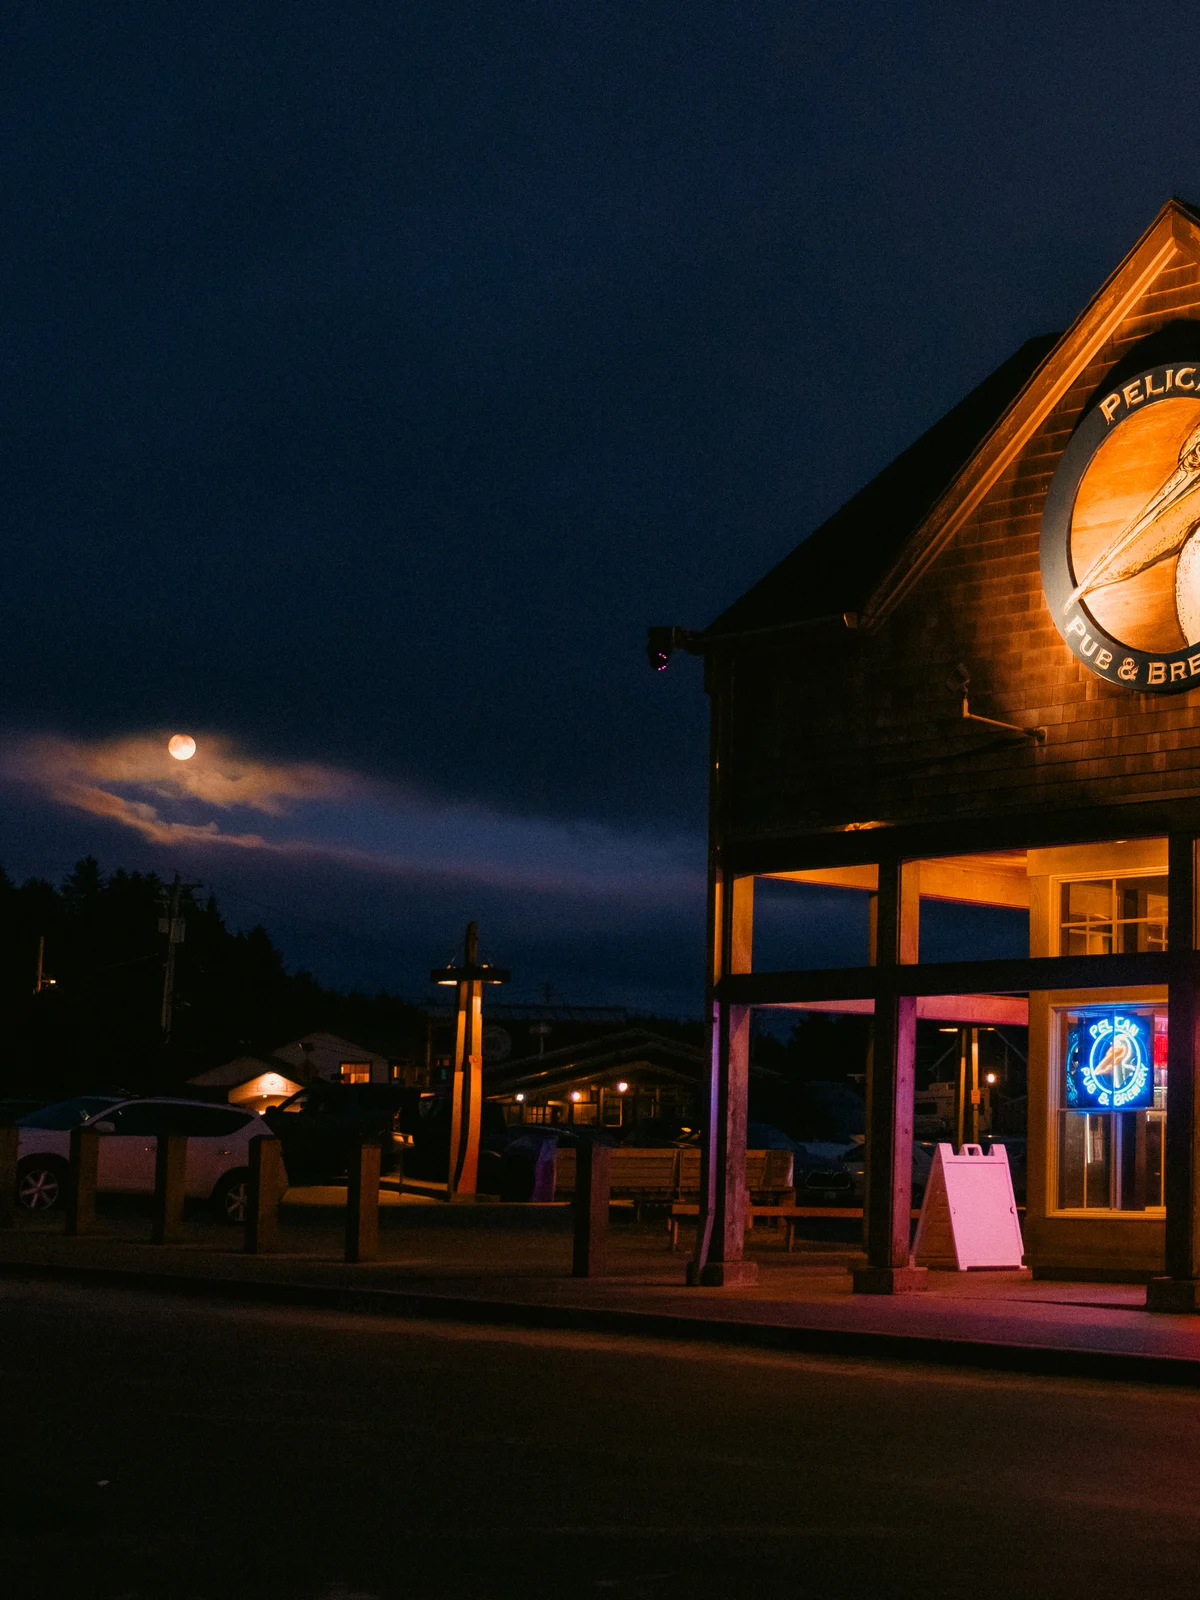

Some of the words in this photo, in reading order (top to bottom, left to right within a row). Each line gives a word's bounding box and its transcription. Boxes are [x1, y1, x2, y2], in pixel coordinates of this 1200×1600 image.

[1064, 615, 1113, 670] PUB
[1118, 656, 1139, 681] &
[1089, 1016, 1139, 1039] PELCAN
[1080, 1066, 1097, 1094] PUB
[1098, 1092, 1110, 1106] &
